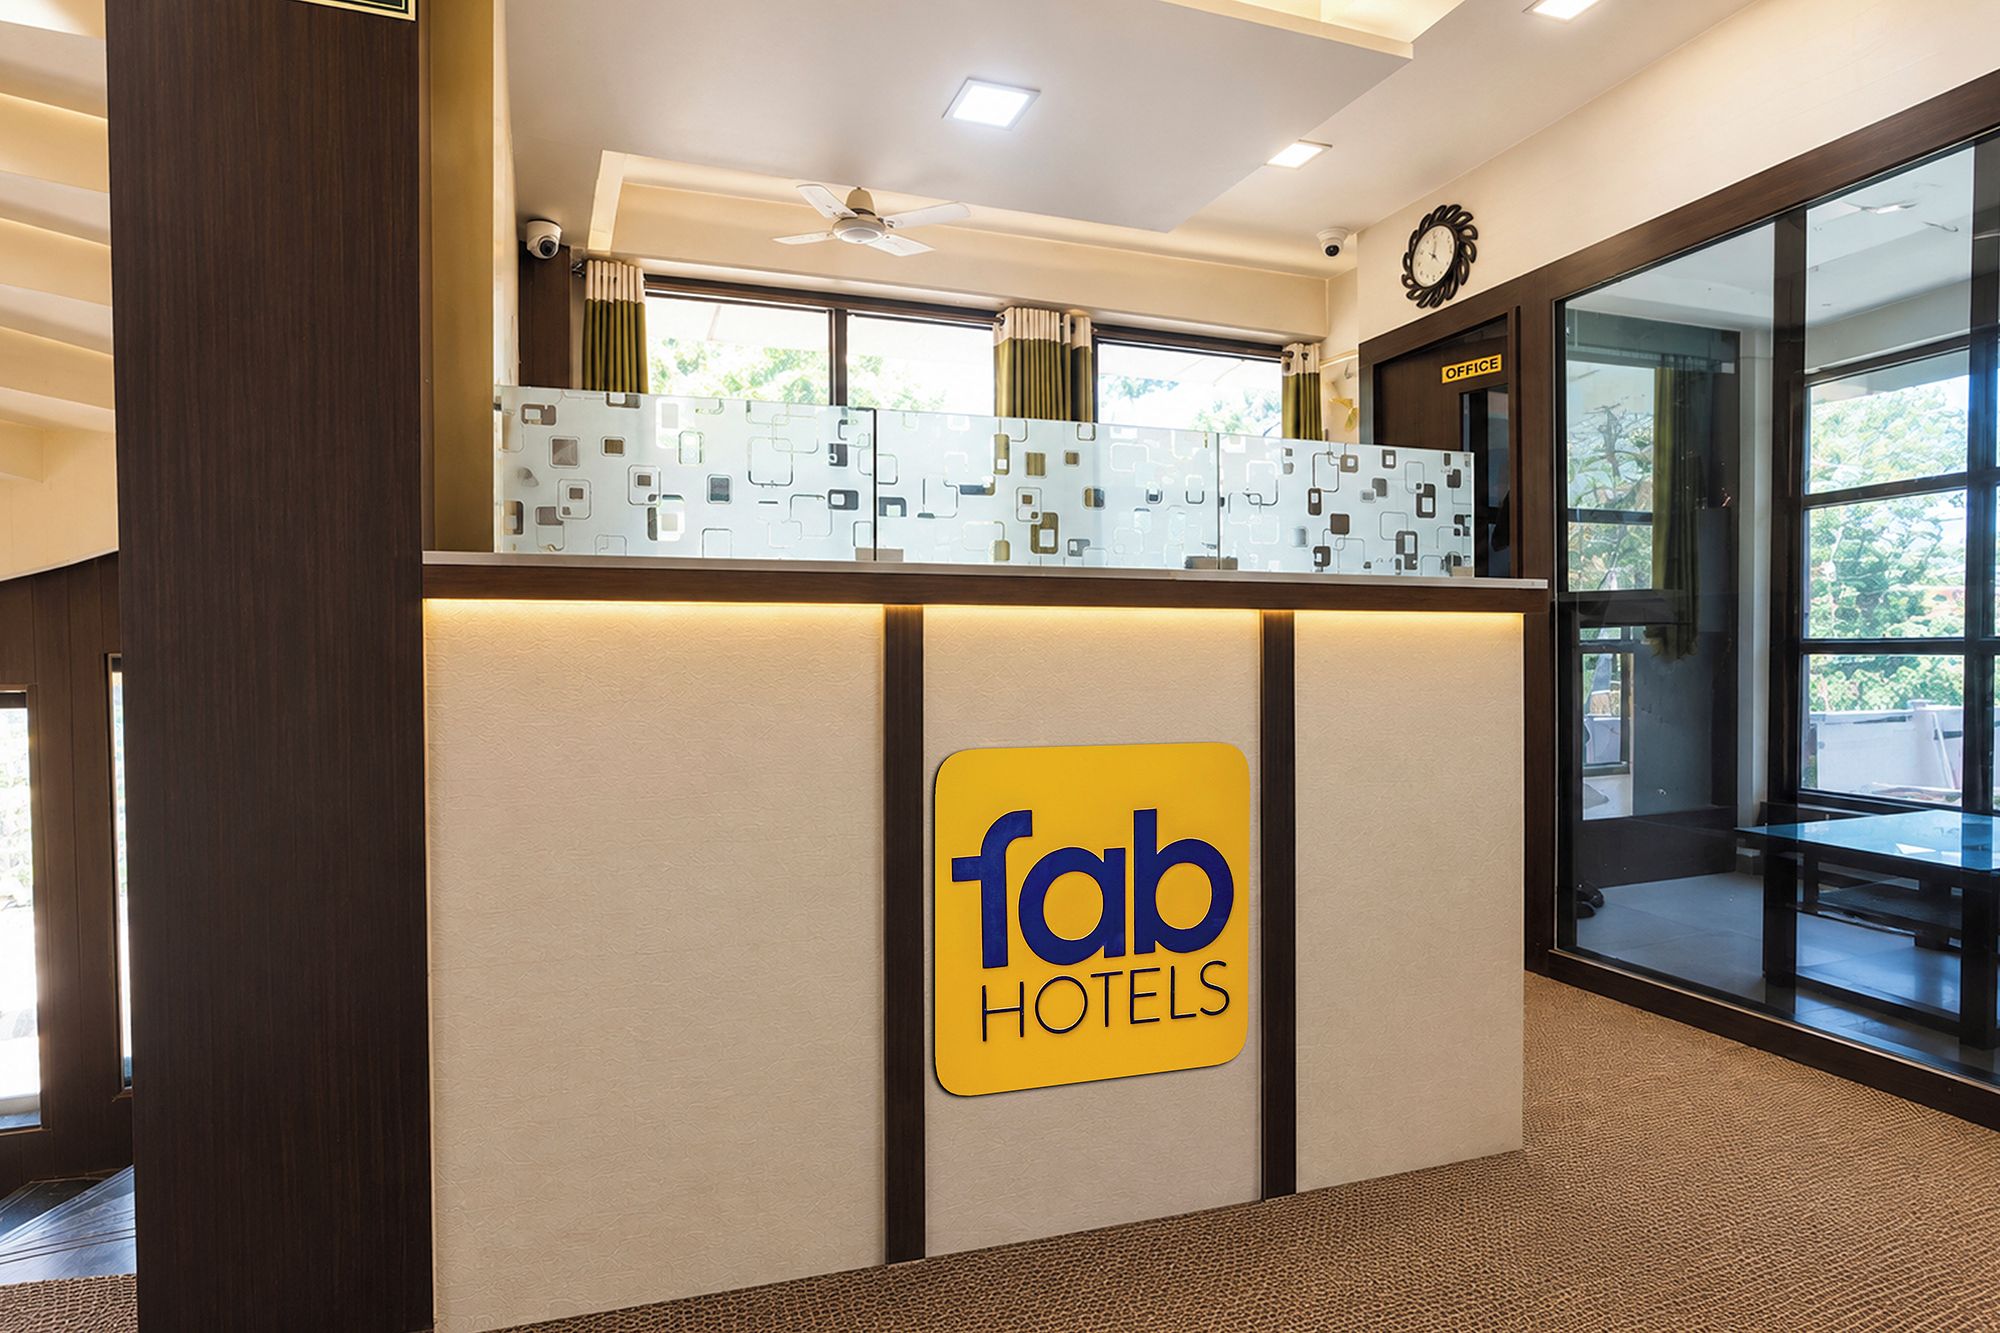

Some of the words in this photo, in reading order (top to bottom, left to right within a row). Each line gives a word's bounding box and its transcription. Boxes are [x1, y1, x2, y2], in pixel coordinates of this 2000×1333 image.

[1446, 358, 1499, 379] OFFICE
[952, 809, 1234, 969] fab
[982, 960, 1230, 1042] HOTELS
